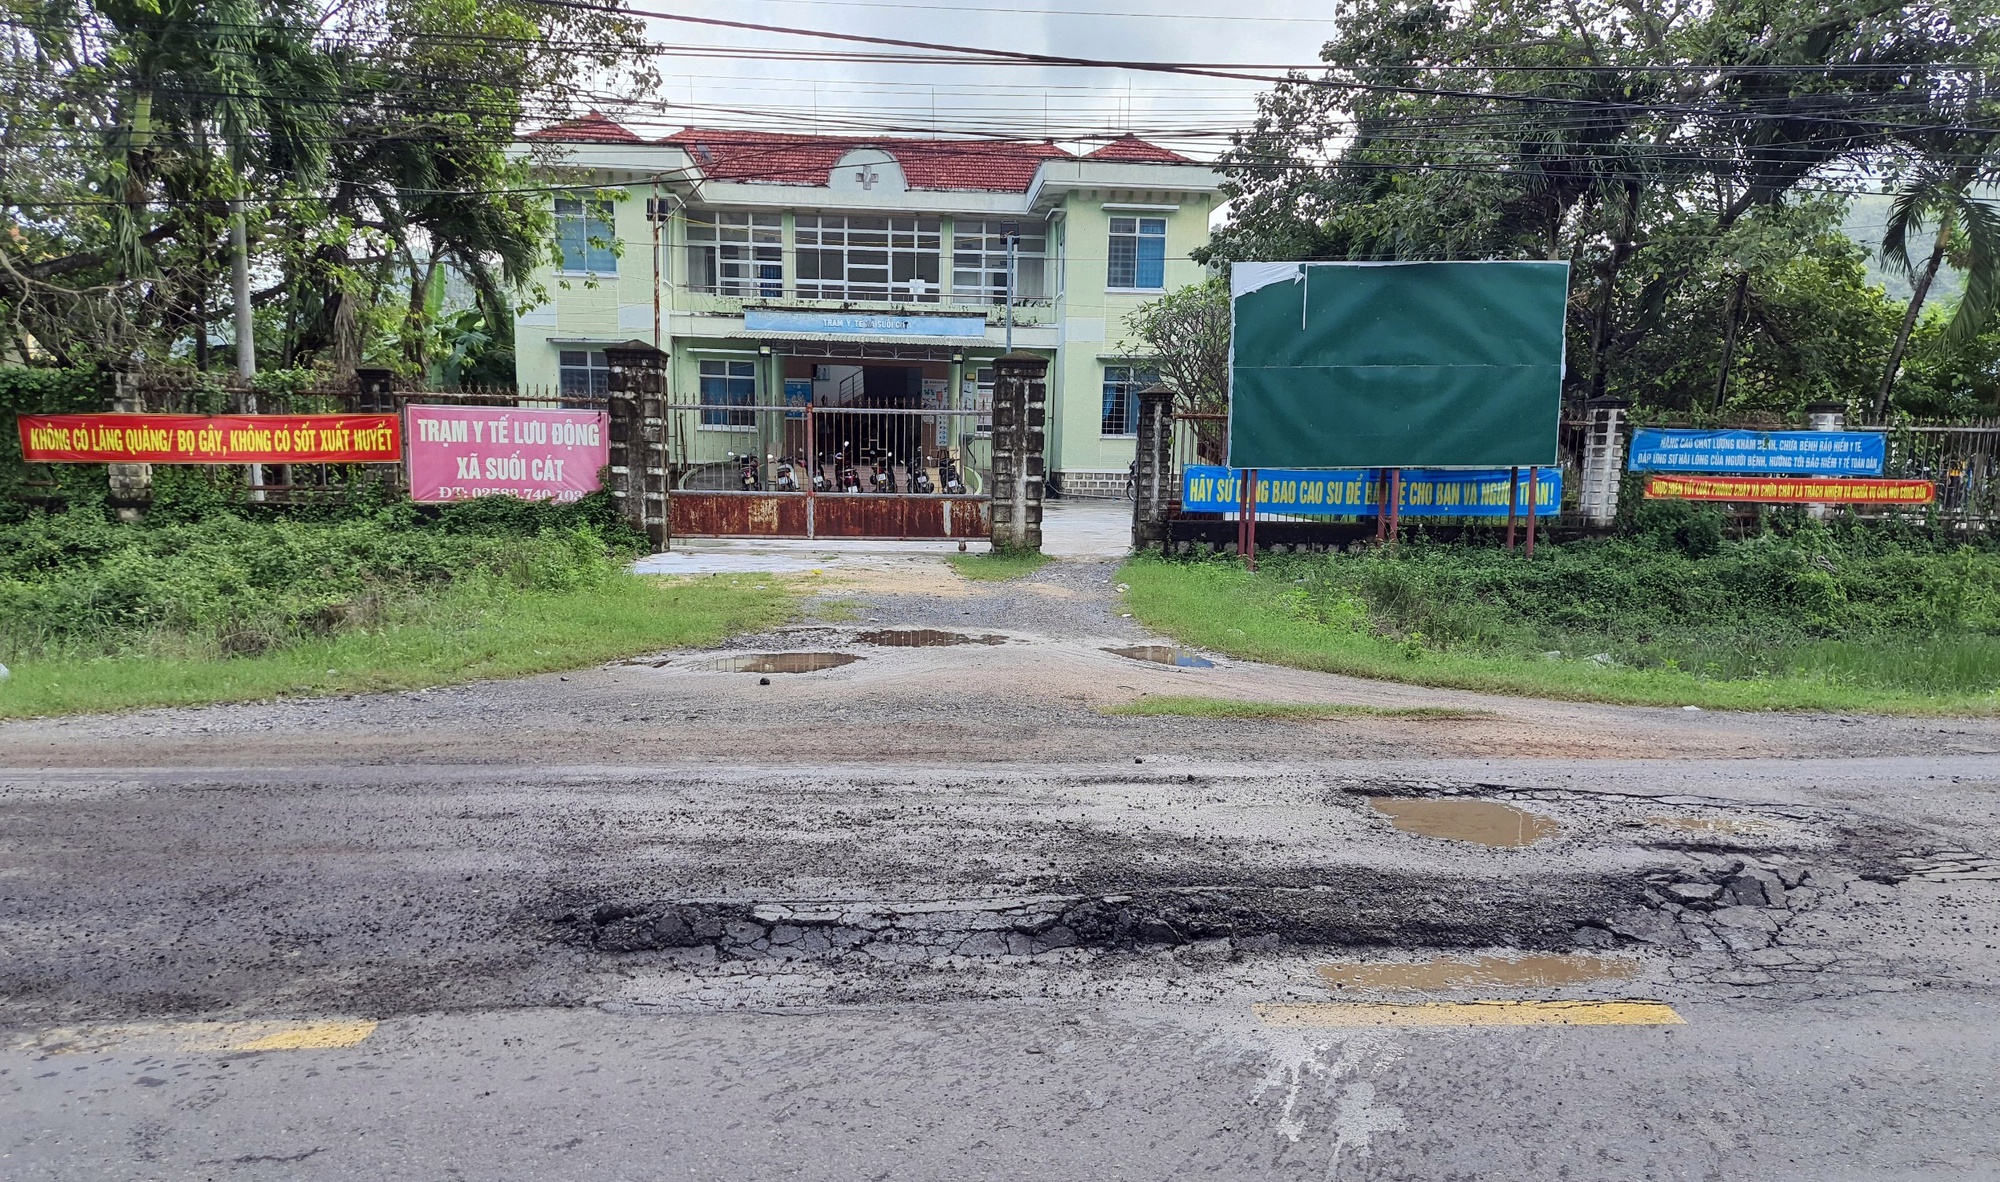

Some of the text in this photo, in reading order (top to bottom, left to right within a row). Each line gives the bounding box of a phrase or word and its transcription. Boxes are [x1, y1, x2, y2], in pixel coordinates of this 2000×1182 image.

[846, 319, 850, 327] Y
[30, 422, 71, 450] KHÔNG
[72, 422, 89, 451] CÓ
[91, 424, 123, 451] LĂNG
[177, 430, 196, 456] BỌ
[198, 424, 226, 456] GẬY,
[230, 424, 271, 452] KHÔNG
[274, 424, 291, 452] CÓ
[294, 421, 316, 451] SỐT
[320, 421, 349, 451] XUẤT
[354, 420, 392, 451] HUYẾT
[418, 414, 600, 450] TRẠM Y TẾ LƯU ĐỘNG
[1680, 438, 1693, 449] CAO
[1712, 438, 1734, 451] LƯỢNG
[1736, 436, 1756, 450] KHÁM
[1800, 438, 1818, 453] BỆNH
[1820, 437, 1832, 452] BẢO
[1850, 442, 1854, 452] Y
[456, 450, 564, 482] XÃ SUỐI CÁT
[1668, 454, 1678, 467] SỰ
[1710, 451, 1724, 466] CỦA
[1838, 458, 1843, 468] Y
[438, 486, 467, 499] ĐT:
[1190, 474, 1214, 502] HÃY
[1216, 472, 1234, 502] SỬ
[1272, 480, 1297, 504] BAO
[1300, 481, 1323, 504] CAO
[1326, 481, 1343, 505] SU
[1346, 473, 1363, 505] ĐỂ
[1409, 482, 1433, 505] CHO
[1435, 482, 1460, 510] BẠN
[1463, 478, 1478, 505] VÀ
